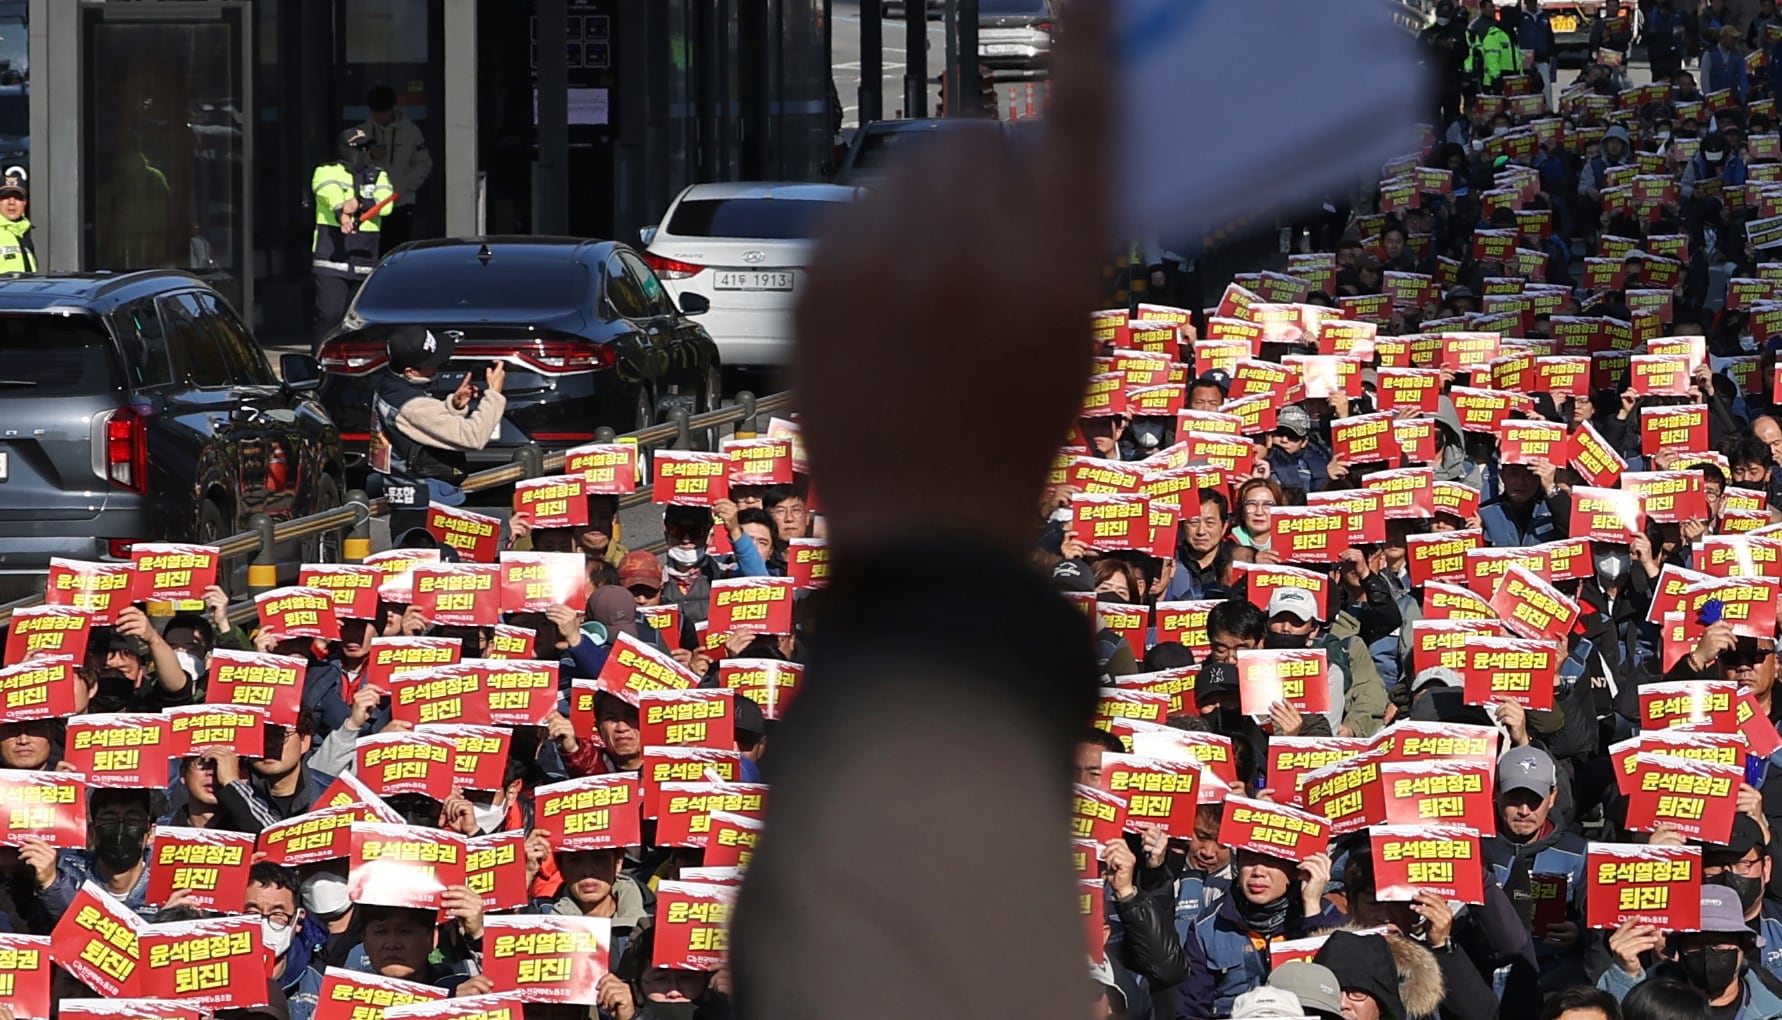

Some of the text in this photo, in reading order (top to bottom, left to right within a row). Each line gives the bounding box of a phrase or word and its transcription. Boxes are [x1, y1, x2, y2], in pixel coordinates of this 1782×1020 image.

[753, 274, 786, 287] 1913
[1382, 376, 1435, 390] 윤석열정권
[1394, 388, 1423, 403] 퇴진!
[1337, 420, 1390, 441] 윤석열정권
[1647, 413, 1703, 431] 윤석열정권
[1349, 435, 1379, 454] 퇴진!
[1508, 428, 1563, 443] 윤석열정권
[1660, 428, 1689, 445] 퇴진!
[1521, 441, 1550, 454] 퇴진!
[1577, 433, 1620, 473] 윤석열정권
[1578, 451, 1605, 474] 퇴진!
[522, 483, 582, 503] 윤석열정권
[535, 499, 568, 517] 퇴진!
[1079, 503, 1144, 520] 윤석열정권
[1094, 520, 1129, 537] 퇴진!
[138, 554, 211, 570] 윤석열정권
[154, 569, 192, 588] 퇴진!
[265, 596, 329, 616] 윤석열정권
[717, 586, 787, 606] 윤석열정권
[1507, 580, 1571, 622] 윤석열정권
[283, 611, 318, 627] 퇴진!
[732, 603, 770, 621] 퇴진!
[1513, 602, 1551, 630] 퇴진!
[75, 726, 162, 749] 윤석열정권
[95, 749, 141, 771] 퇴진!
[1643, 772, 1733, 797] 윤석열정권
[545, 785, 631, 816] 윤석열정권
[1657, 795, 1707, 819] 퇴진!
[565, 810, 611, 835] 퇴진!
[160, 844, 245, 865] 윤석열정권
[1384, 839, 1473, 861] 윤석열정권
[173, 868, 220, 890] 퇴진!
[1408, 862, 1455, 883] 퇴진!
[1599, 861, 1692, 884] 윤석열정권
[1621, 886, 1670, 910] 퇴진!
[149, 931, 252, 968] 윤석열정권
[494, 932, 598, 958] 윤석열정권
[175, 962, 230, 993] 퇴진!
[517, 957, 567, 983] 퇴진!
